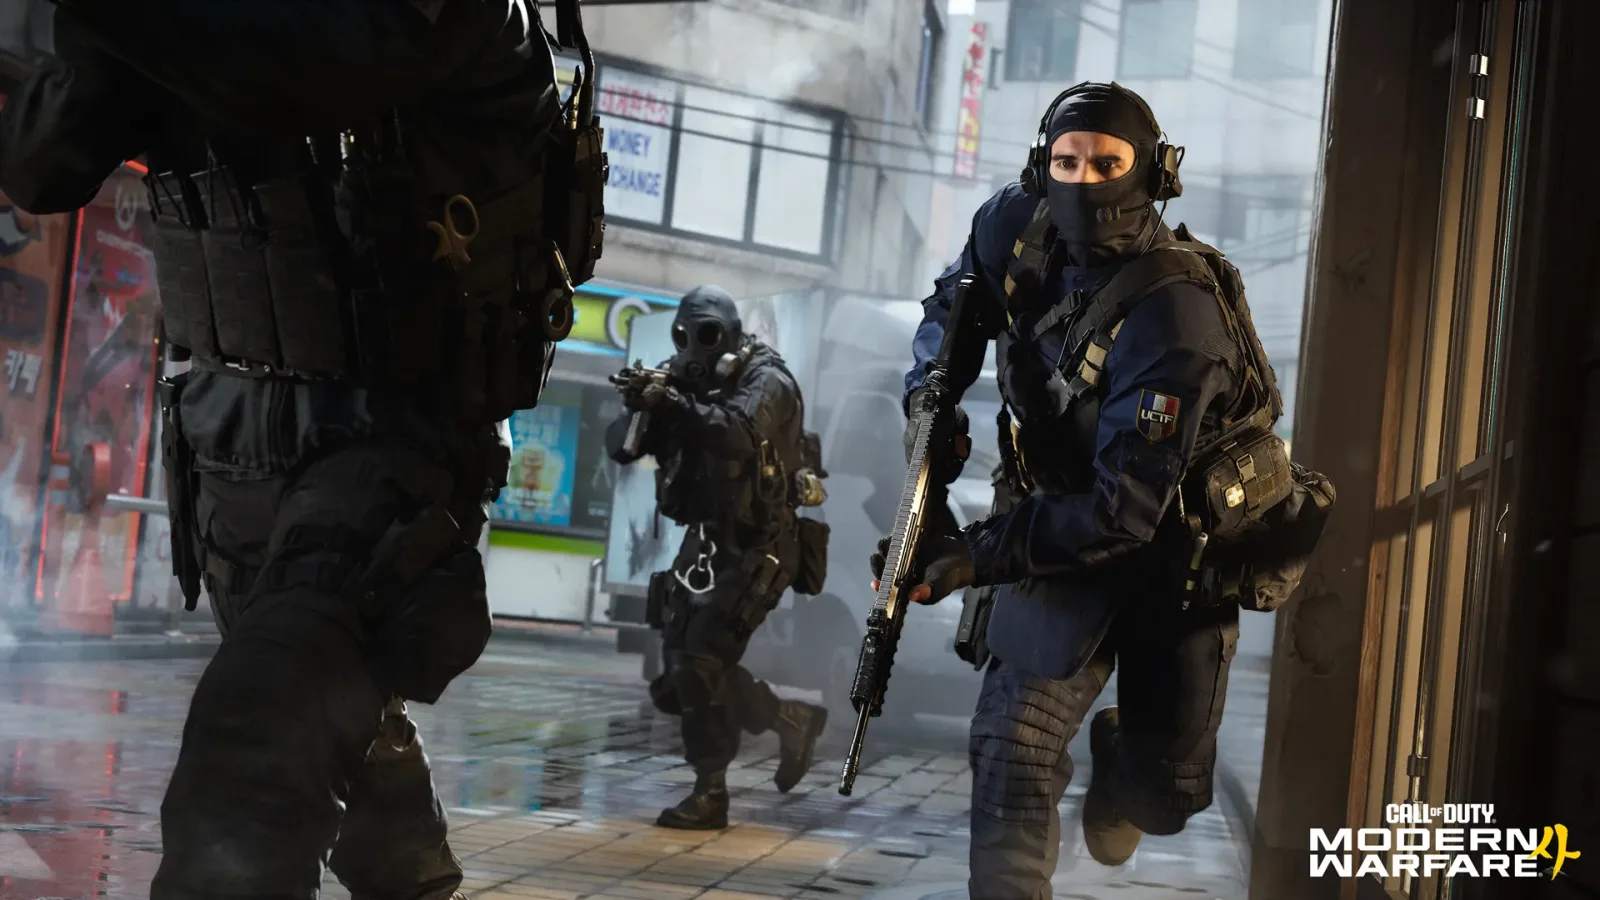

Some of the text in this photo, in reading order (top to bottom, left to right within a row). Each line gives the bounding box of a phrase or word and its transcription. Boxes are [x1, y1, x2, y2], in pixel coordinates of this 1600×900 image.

[608, 127, 652, 158] MONEY
[608, 164, 662, 197] CHANGE
[1141, 409, 1173, 424] UCTF
